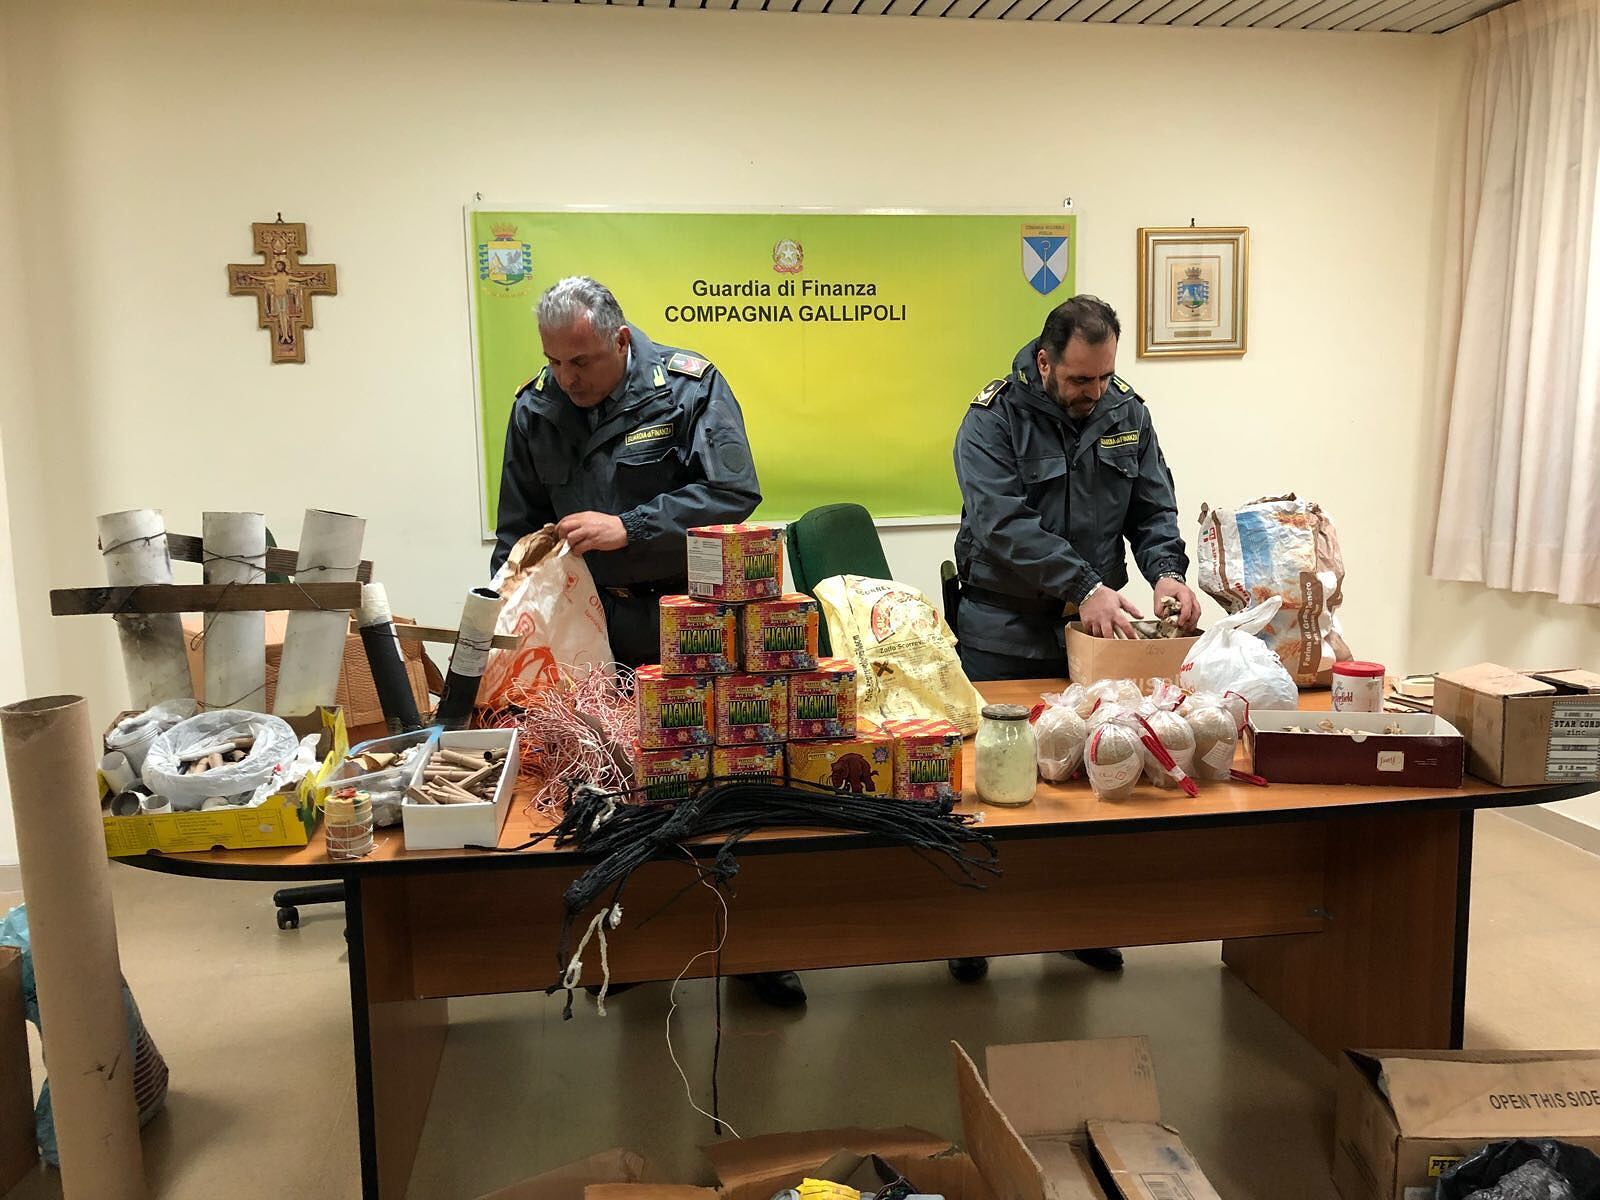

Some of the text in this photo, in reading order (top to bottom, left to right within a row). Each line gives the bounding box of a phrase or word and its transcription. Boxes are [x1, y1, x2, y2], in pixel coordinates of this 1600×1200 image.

[692, 279, 877, 297] Guardia di Finanza
[665, 304, 907, 322] COMPAGNIA GALLIPOLI
[680, 629, 722, 654] MAGNOLIA
[764, 626, 805, 651] MAGNOLIA
[1304, 631, 1312, 641] di
[1303, 642, 1312, 667] Farina
[661, 702, 704, 728] MAGNOLIA
[729, 700, 770, 725] MAGNOLIA
[797, 694, 837, 719] MAGNOLIA
[1554, 720, 1600, 728] STAR CORD
[909, 759, 949, 783] MAGNOLIA
[1489, 1090, 1600, 1110] OPEN THIS SIDE
